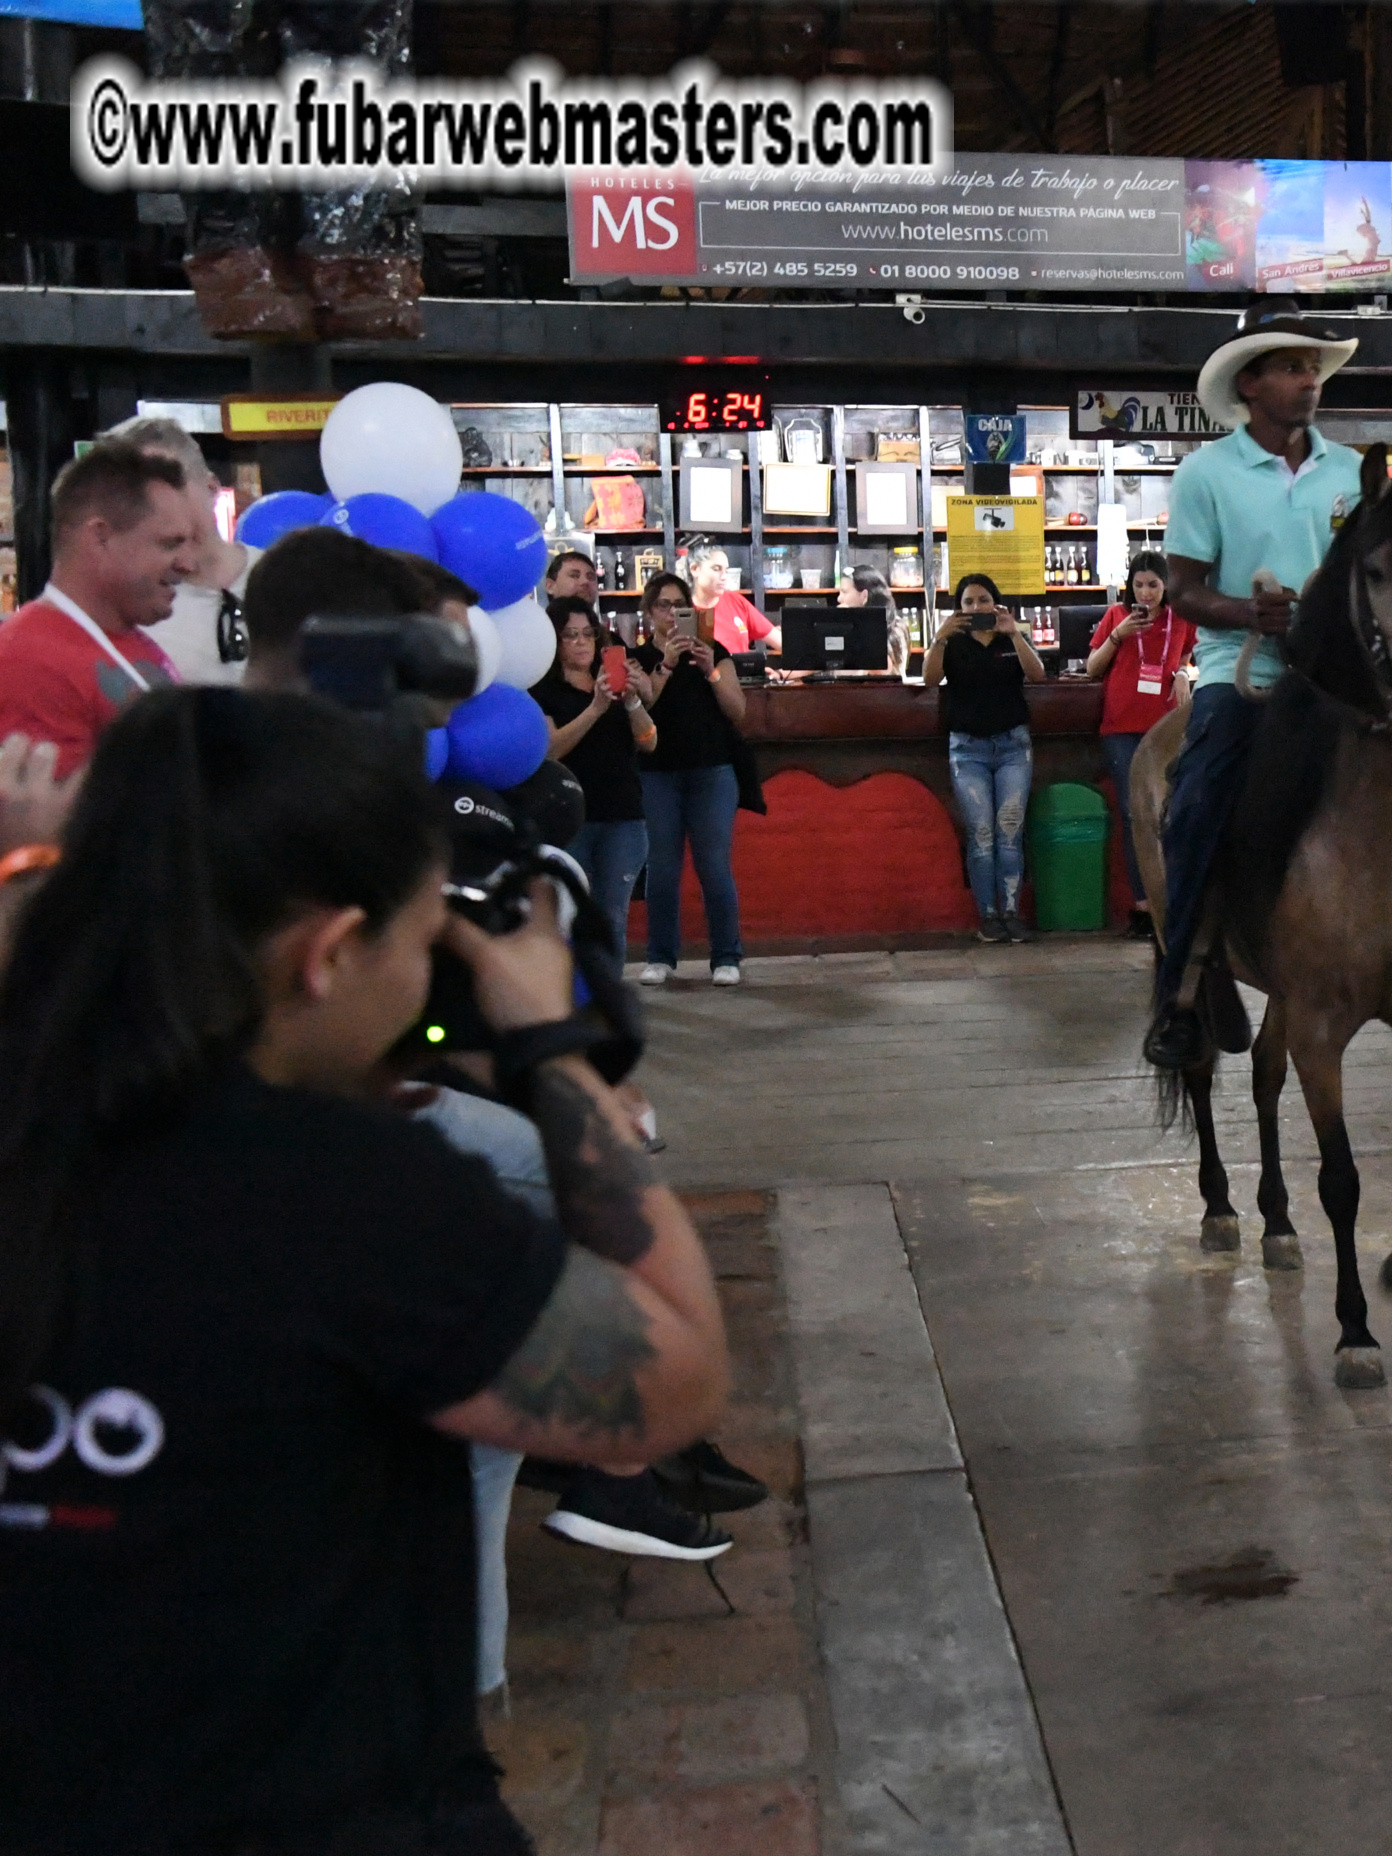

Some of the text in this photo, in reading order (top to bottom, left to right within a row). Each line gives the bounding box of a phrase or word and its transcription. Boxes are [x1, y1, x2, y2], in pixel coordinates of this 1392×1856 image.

[591, 177, 675, 190] HOTELES
[728, 167, 785, 191] mejor
[853, 171, 901, 193] para
[942, 170, 995, 196] viajes
[1002, 168, 1025, 188] de
[1103, 179, 1115, 190] o
[1115, 171, 1179, 199] placer
[725, 200, 1156, 219] MEJOR PRECIO GARANTIZADO POR MEDIO DE NUESTRA PÁGINA WEB
[592, 195, 678, 250] MS
[842, 221, 1048, 243] www.hotelesms.com
[713, 261, 1184, 281] +57(2) 485 5259 01 8000 910098 reservas@hotelesms.com
[1209, 263, 1234, 278] Cali
[1262, 267, 1281, 279] San
[1331, 263, 1388, 279] Villavicencio
[688, 393, 761, 422] 6:24
[1168, 393, 1200, 405] TIEN
[266, 409, 330, 423] RIVERIT
[1141, 406, 1234, 432] LA TIN
[977, 418, 1013, 432] CAJA
